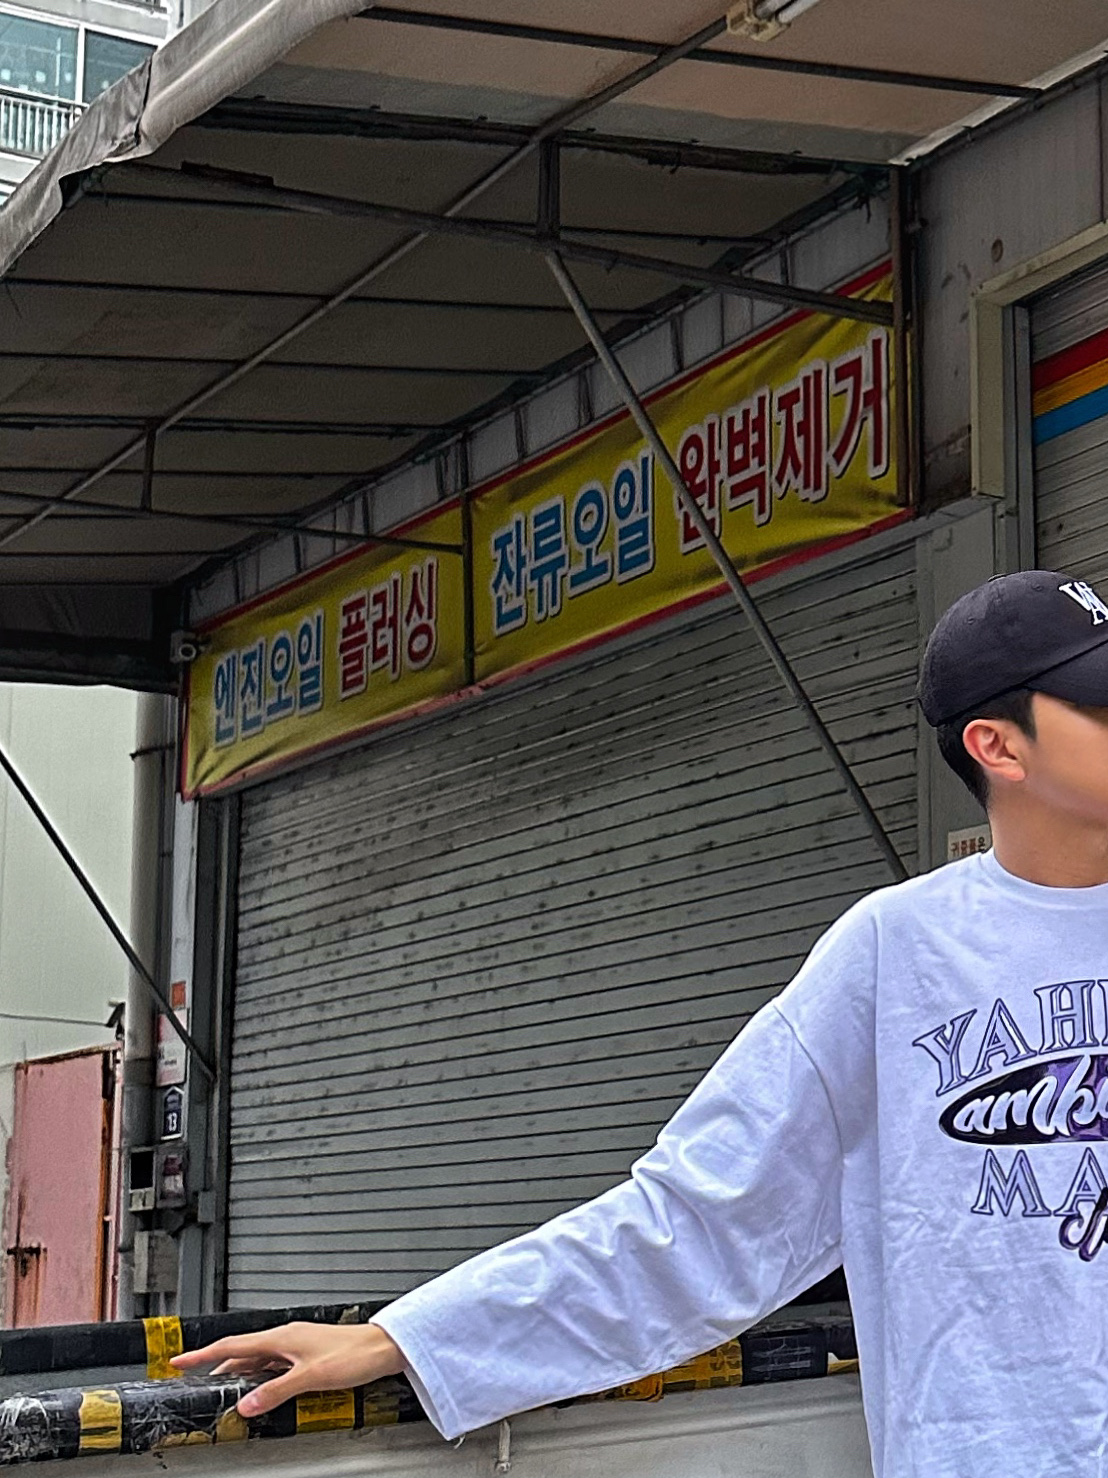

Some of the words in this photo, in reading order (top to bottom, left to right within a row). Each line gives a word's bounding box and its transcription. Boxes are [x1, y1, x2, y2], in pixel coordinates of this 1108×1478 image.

[490, 451, 653, 635] 잔류오일
[675, 332, 887, 551] 완벽제거
[213, 610, 323, 747] 엔진오일
[339, 558, 438, 698] 플러싱
